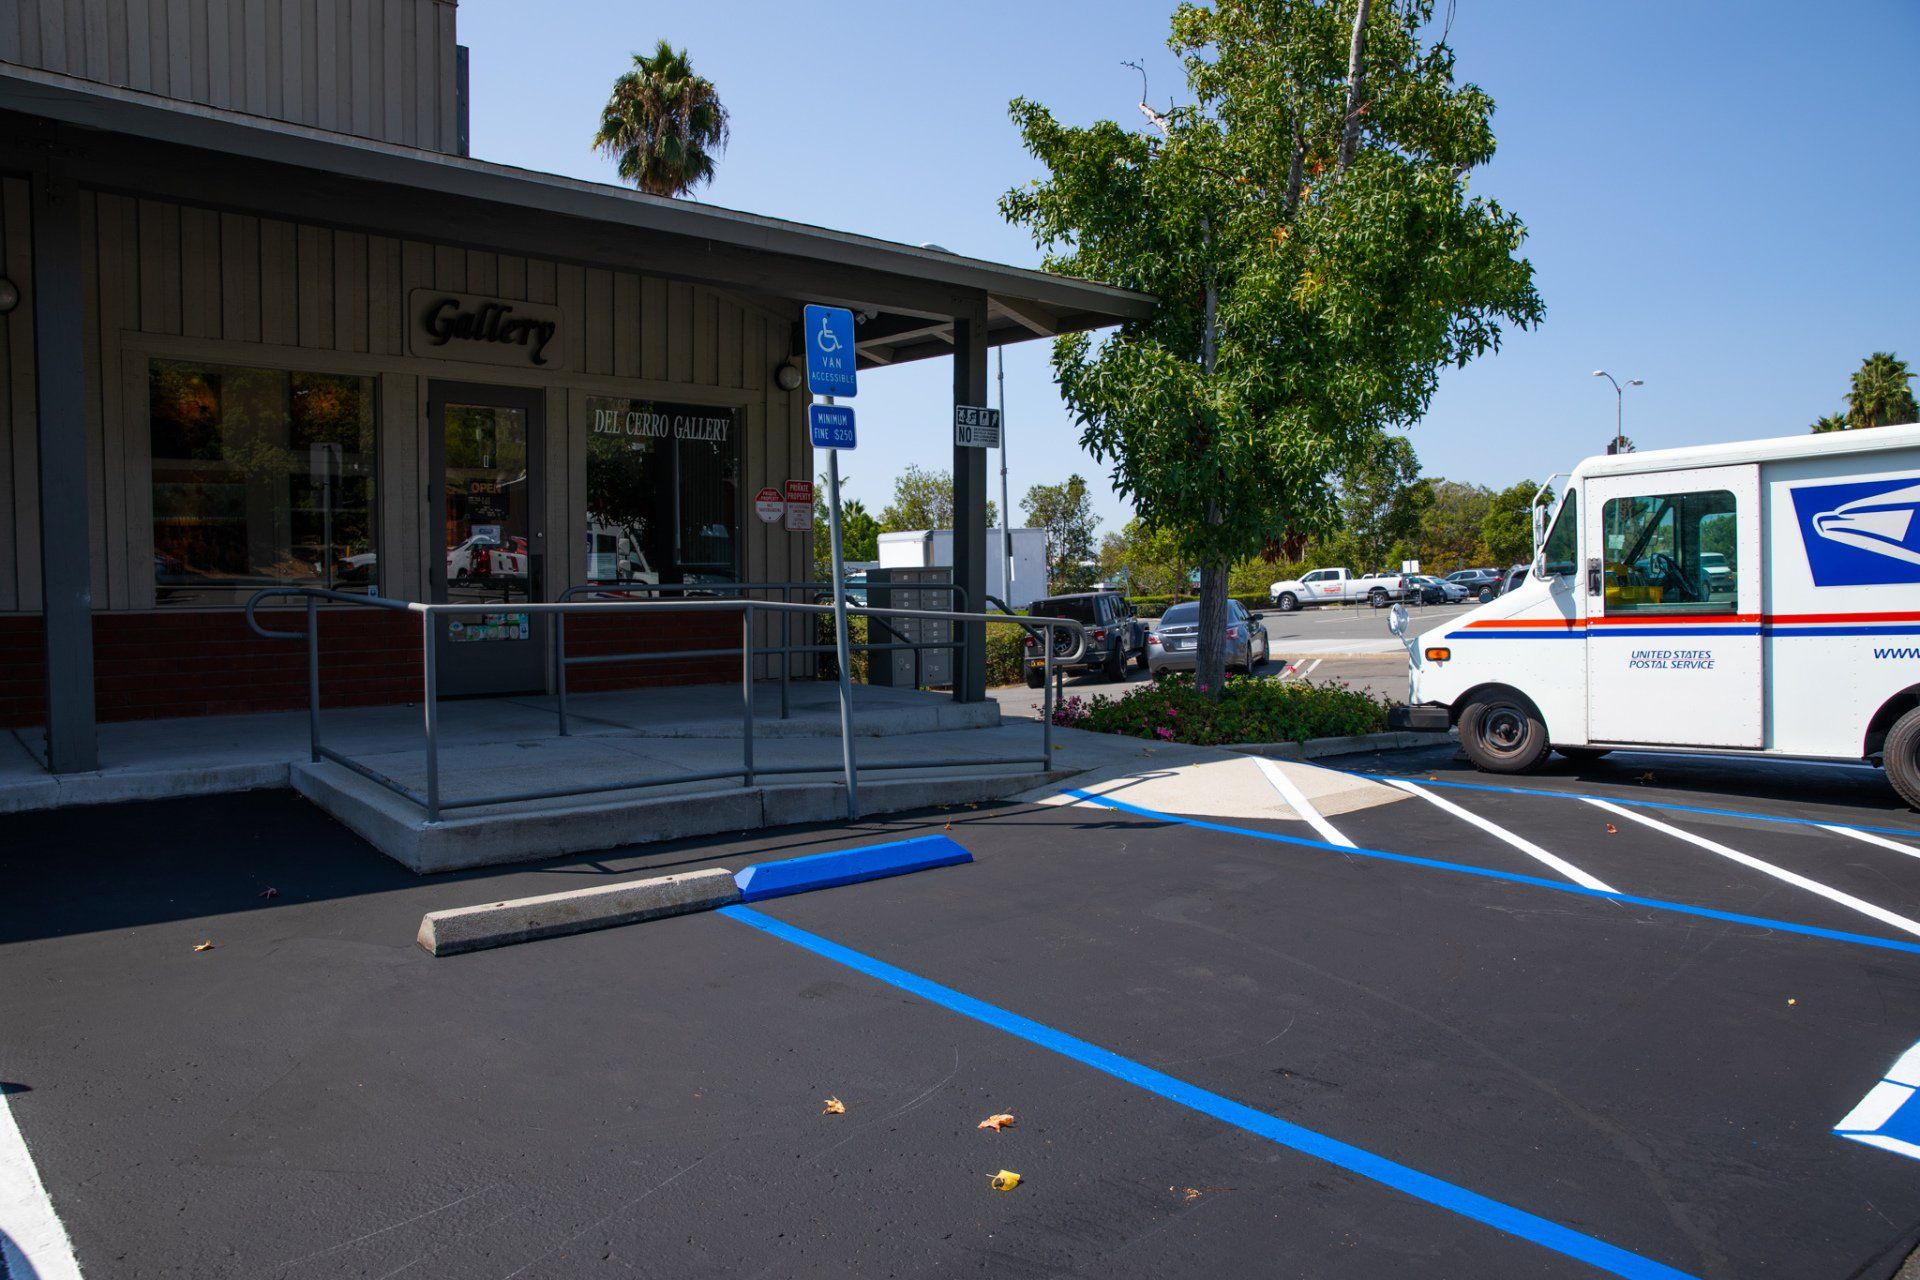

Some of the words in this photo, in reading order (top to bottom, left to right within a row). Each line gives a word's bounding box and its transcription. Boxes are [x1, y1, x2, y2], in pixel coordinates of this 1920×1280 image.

[427, 299, 555, 365] Gallery
[822, 356, 842, 369] VAN
[812, 371, 855, 384] ACCESSIBLE
[594, 409, 621, 434] DEL
[626, 411, 669, 438] CERRO
[673, 415, 730, 441] GALLERY
[818, 413, 848, 426] MINIMUM
[814, 427, 829, 440] FINE
[834, 429, 853, 441] $250
[959, 426, 972, 443] NO
[790, 483, 809, 492] PRIVATE
[788, 492, 811, 501] PROPERTY
[1631, 650, 1671, 659] UNITED
[1672, 650, 1712, 659] STATES
[1628, 660, 1669, 669] POSTAL
[1670, 660, 1715, 669] SERVICE
